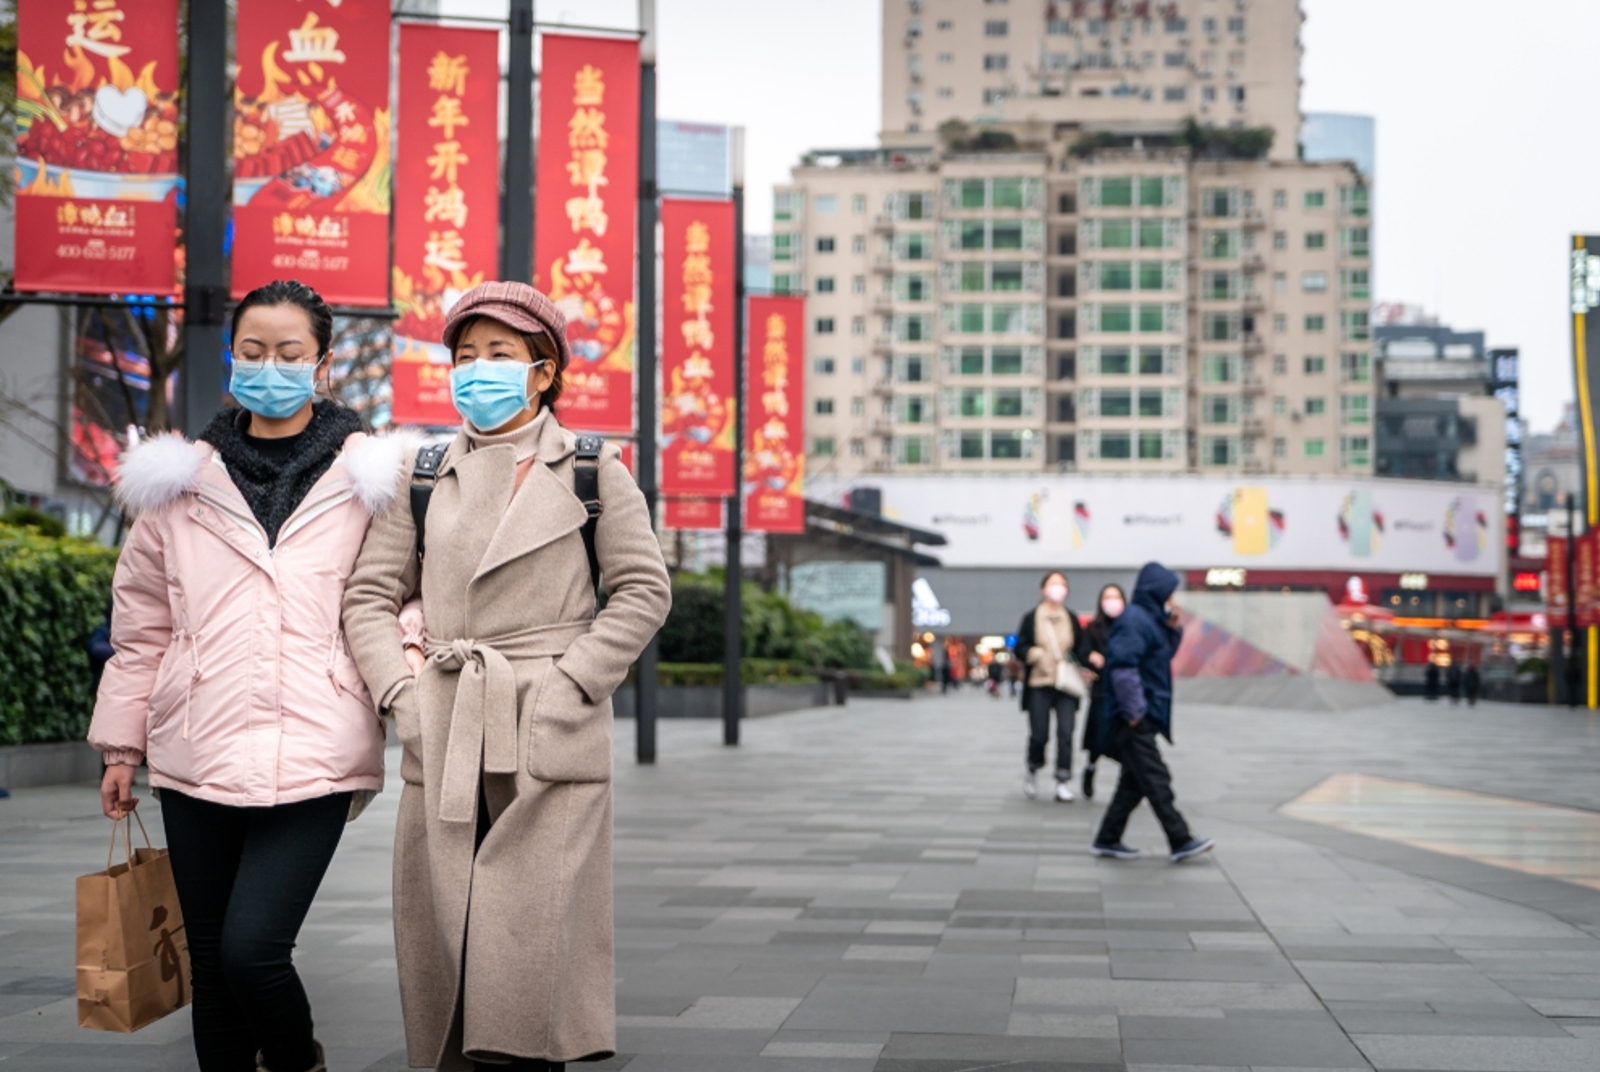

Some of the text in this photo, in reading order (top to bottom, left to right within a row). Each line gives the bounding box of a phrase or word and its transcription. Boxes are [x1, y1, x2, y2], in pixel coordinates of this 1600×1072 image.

[66, 0, 131, 57] 运
[424, 50, 469, 271] 新年开鸿运
[565, 65, 608, 274] 当然谭鸭血
[681, 220, 714, 378] 当然谭鸭血
